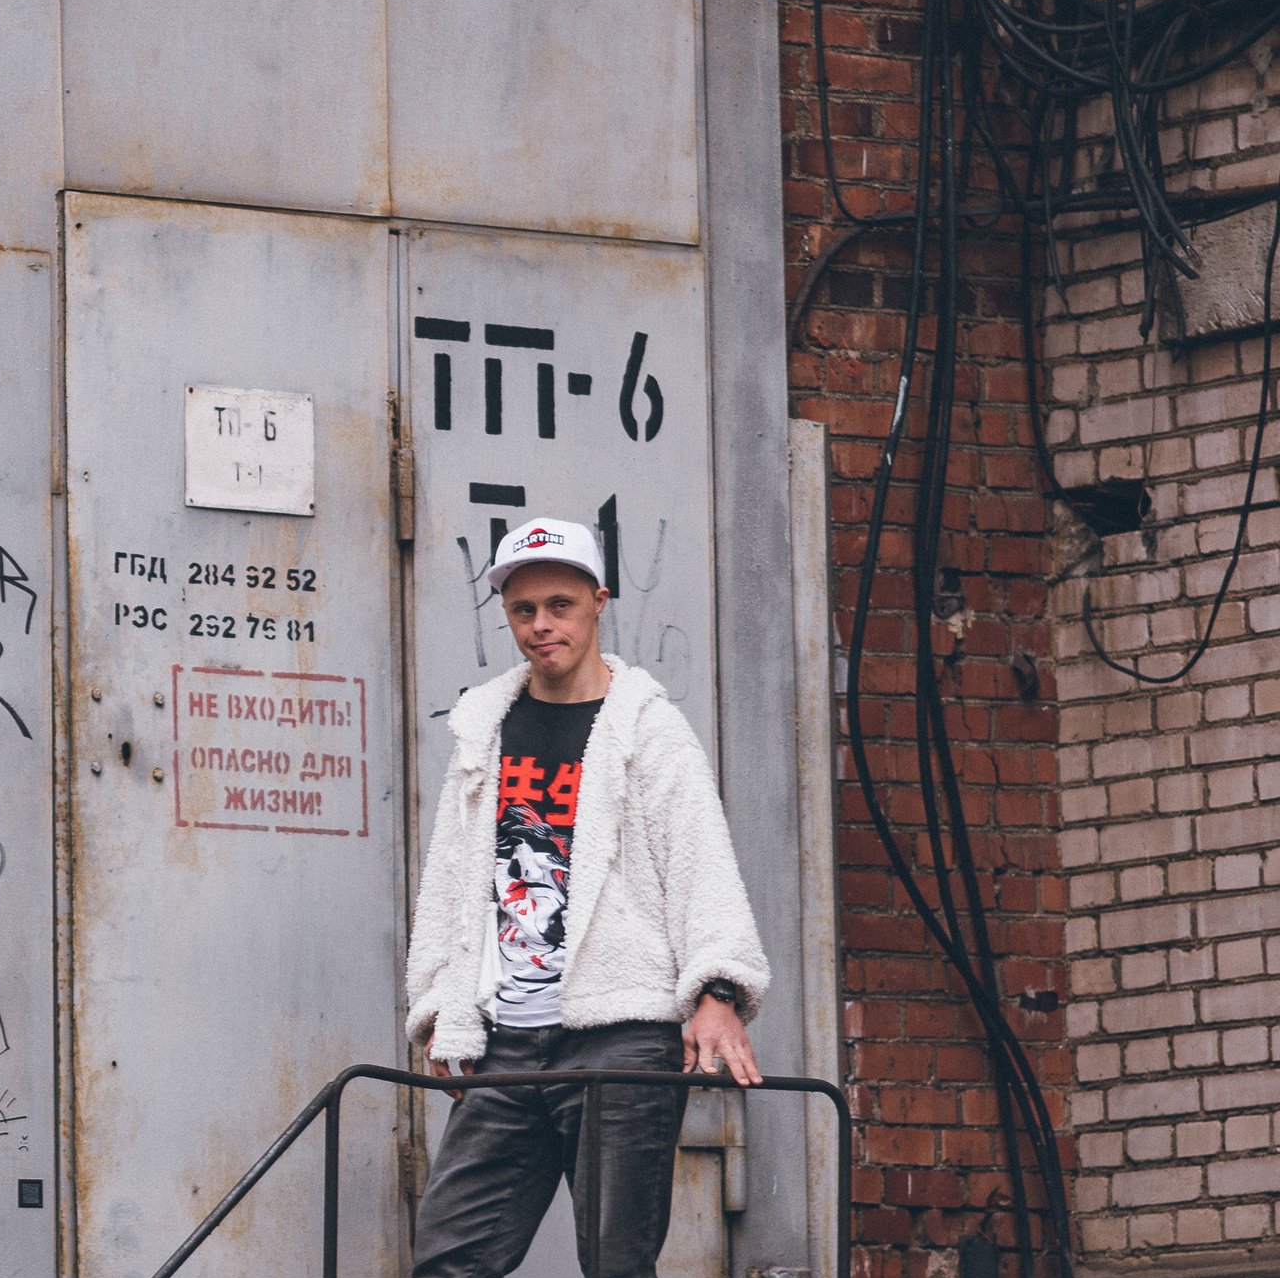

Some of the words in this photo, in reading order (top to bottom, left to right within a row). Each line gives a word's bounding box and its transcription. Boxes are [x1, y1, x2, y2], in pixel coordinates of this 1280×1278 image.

[513, 532, 564, 553] MARTINI
[188, 562, 236, 587] 284
[286, 568, 317, 592] 52
[114, 602, 168, 631] РЭС
[286, 619, 315, 642] 81
[188, 691, 219, 719] НЕ
[227, 693, 352, 729] ВХОДИТЬ!
[190, 746, 291, 775] ОПАСНО
[299, 751, 352, 783] ДЛЯ
[223, 785, 323, 816] ЖИЗНИ!
